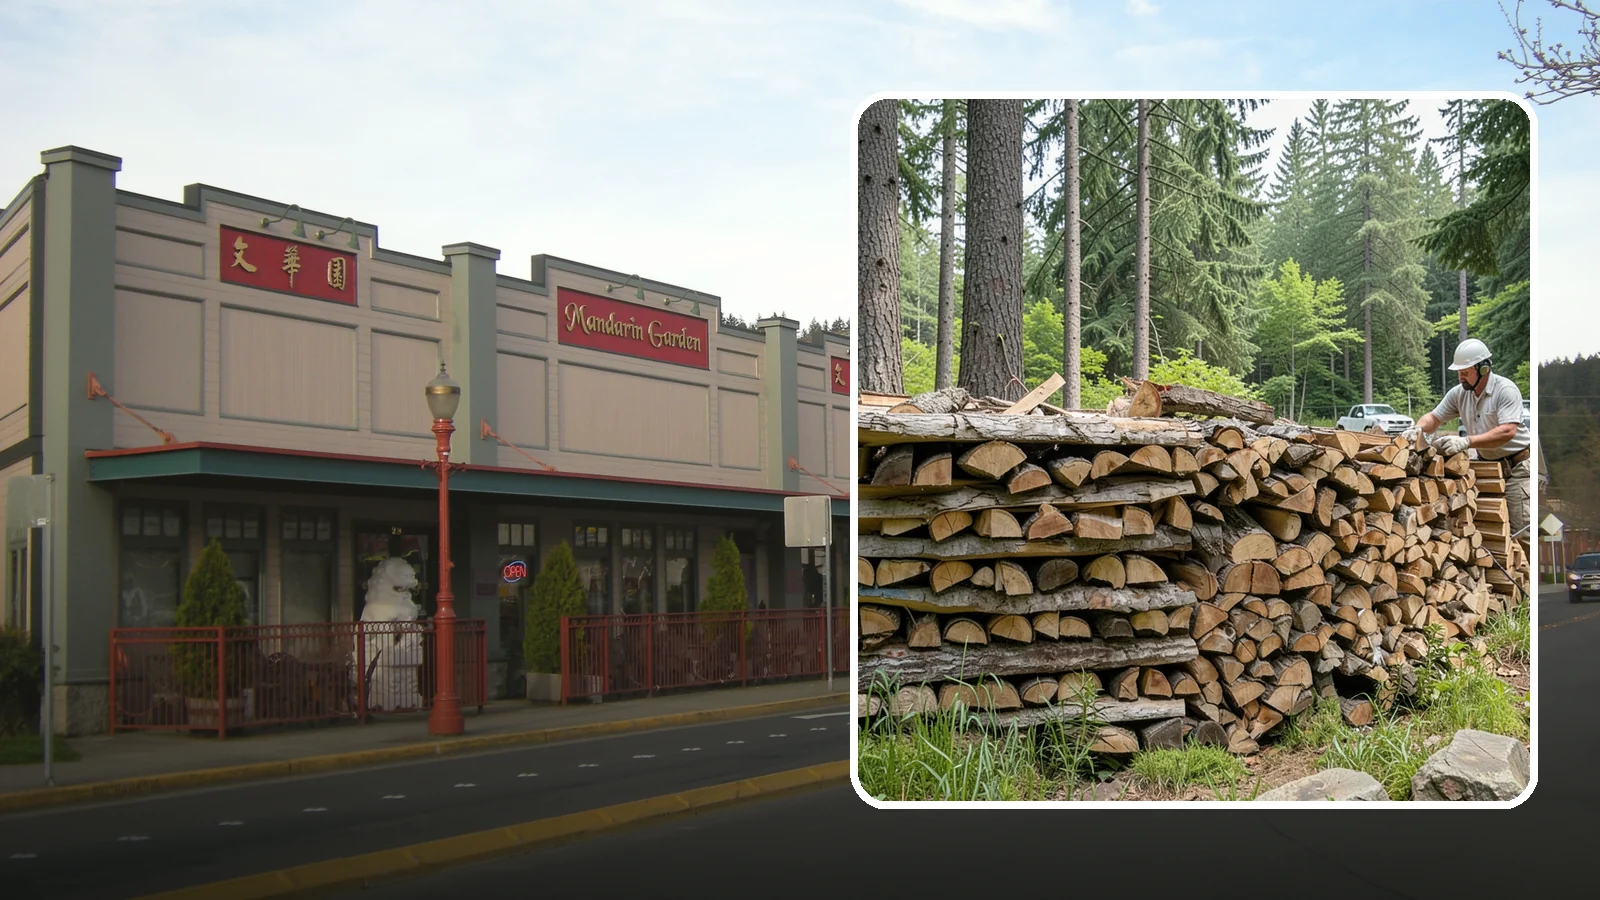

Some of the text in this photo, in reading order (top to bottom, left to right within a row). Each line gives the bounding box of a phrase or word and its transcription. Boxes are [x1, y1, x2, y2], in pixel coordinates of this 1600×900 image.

[231, 236, 346, 291] 文華園
[564, 302, 702, 352] Mandarin Garden
[503, 565, 527, 578] OPEN
